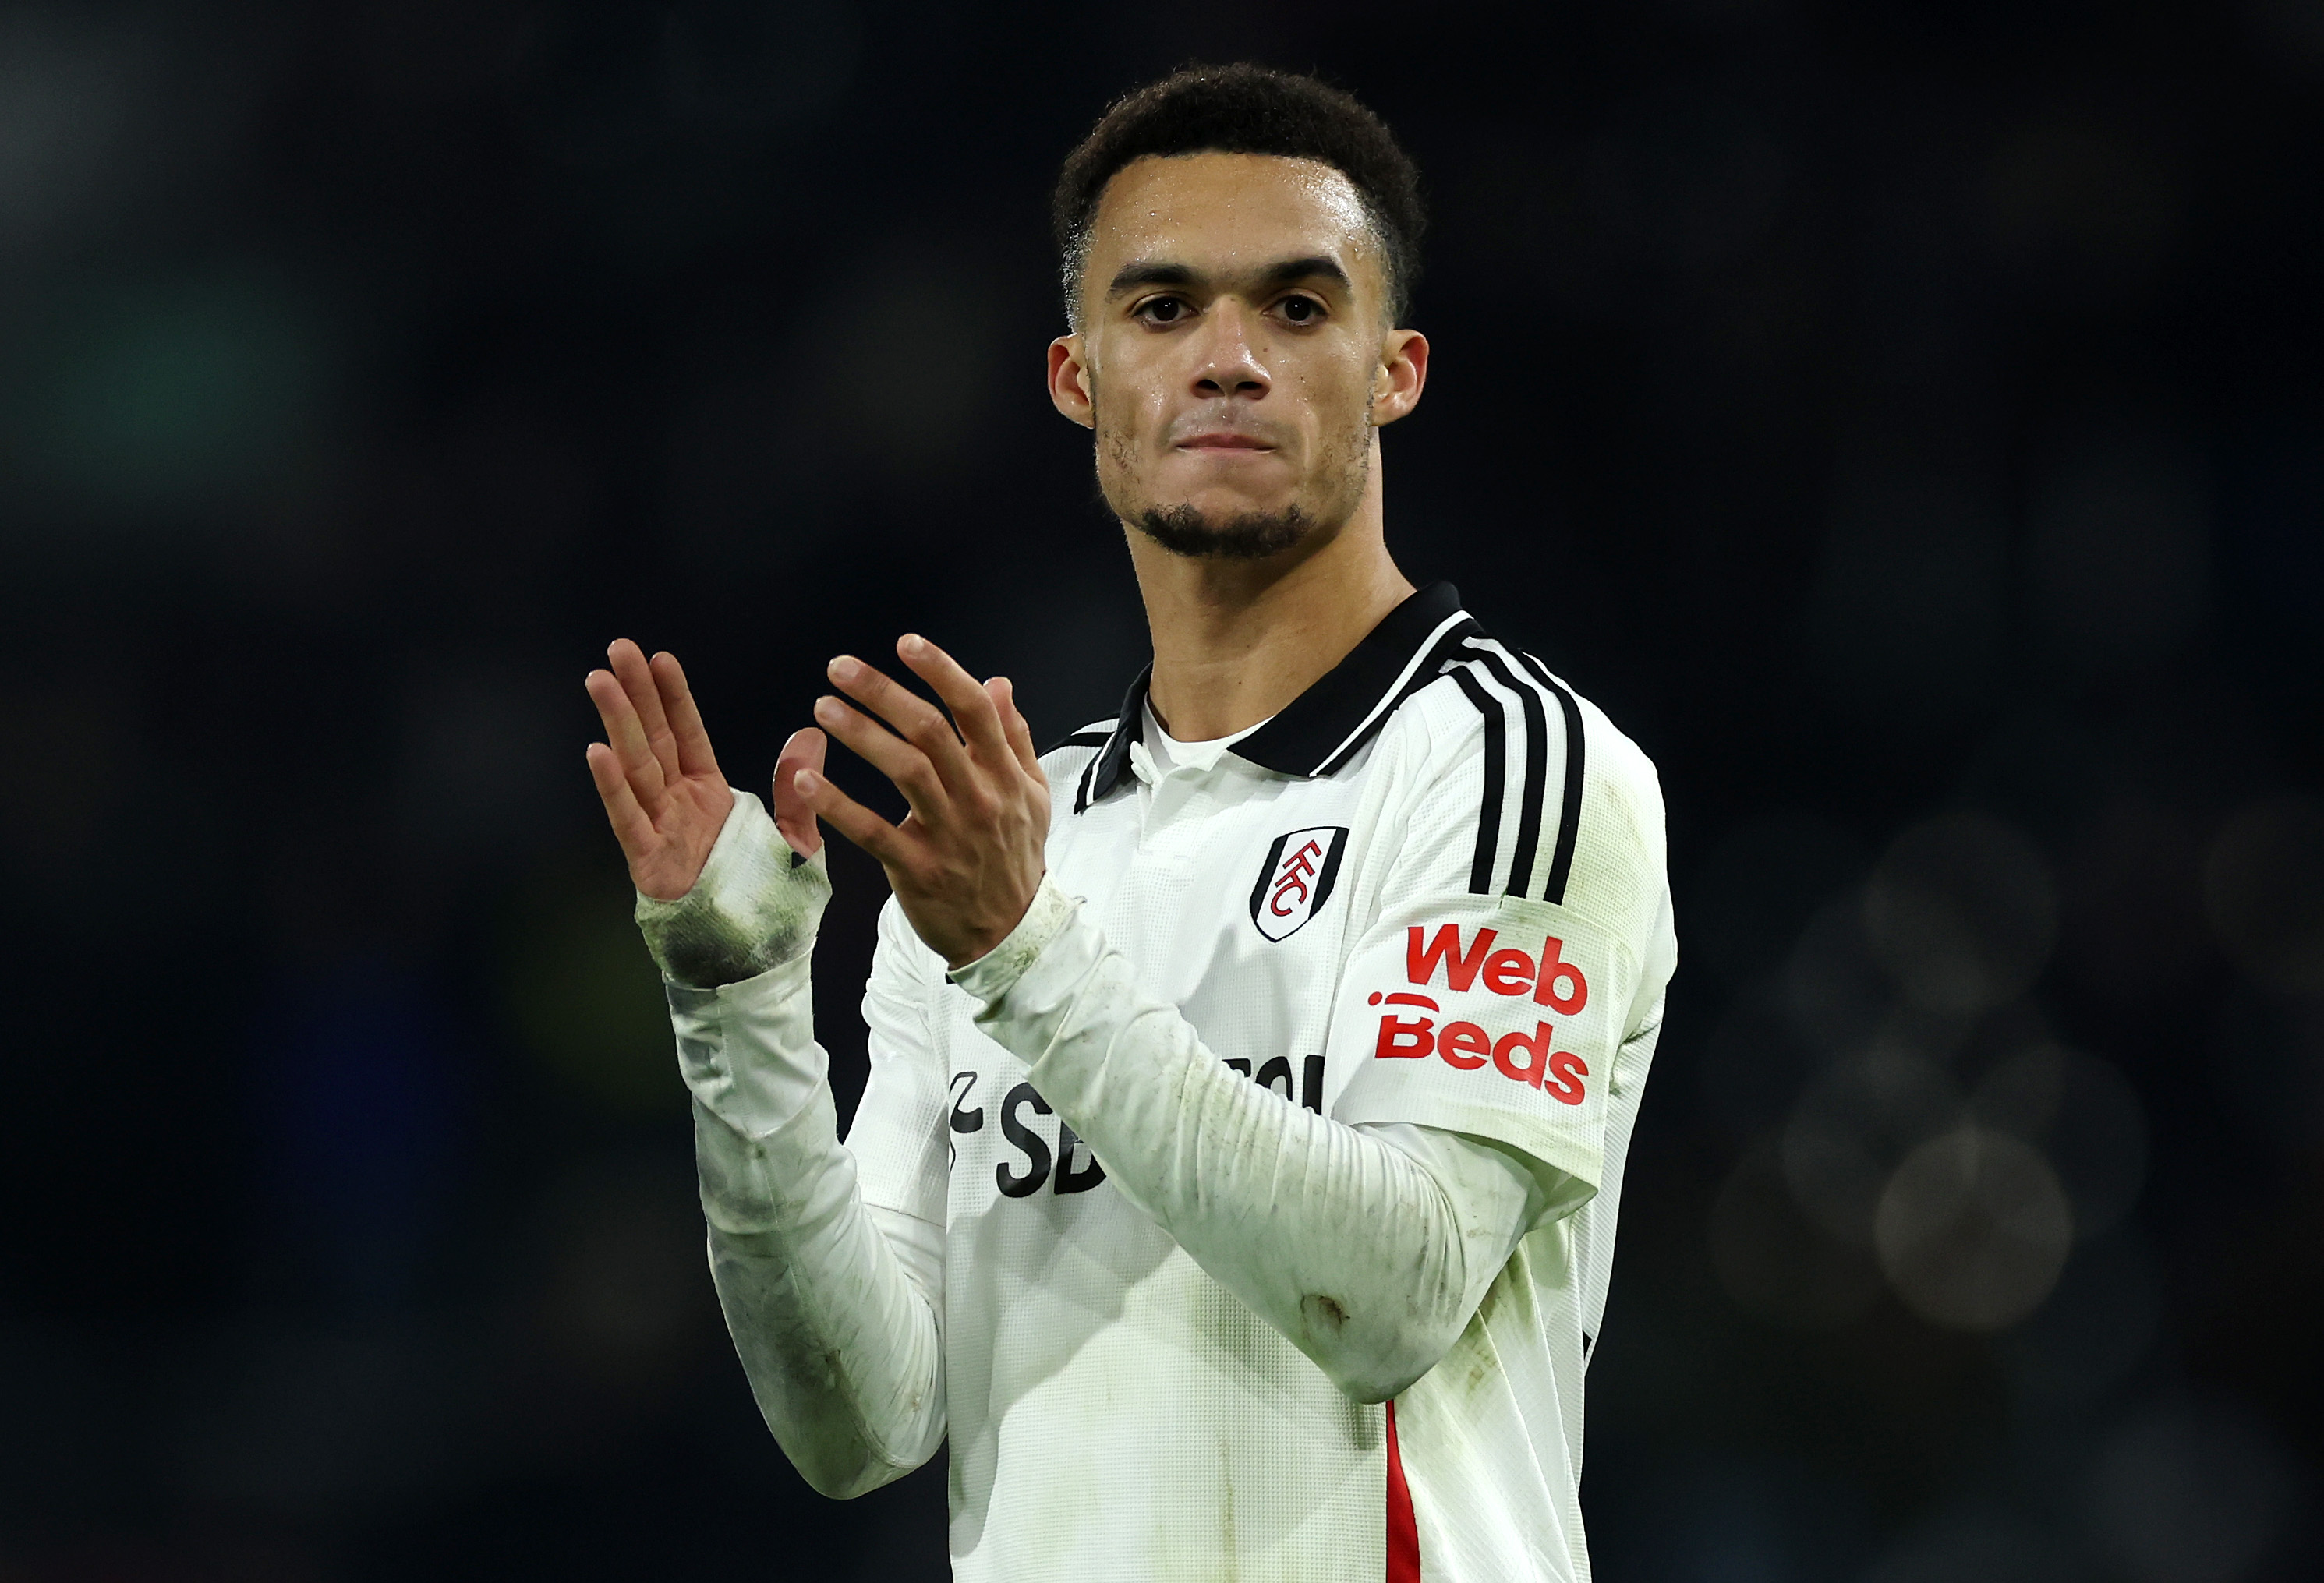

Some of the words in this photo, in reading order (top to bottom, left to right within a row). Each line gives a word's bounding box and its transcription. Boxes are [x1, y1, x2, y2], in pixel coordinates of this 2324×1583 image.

[1270, 839, 1322, 917] FFC
[1406, 923, 1588, 1016] Web
[1367, 991, 1589, 1105] Beds
